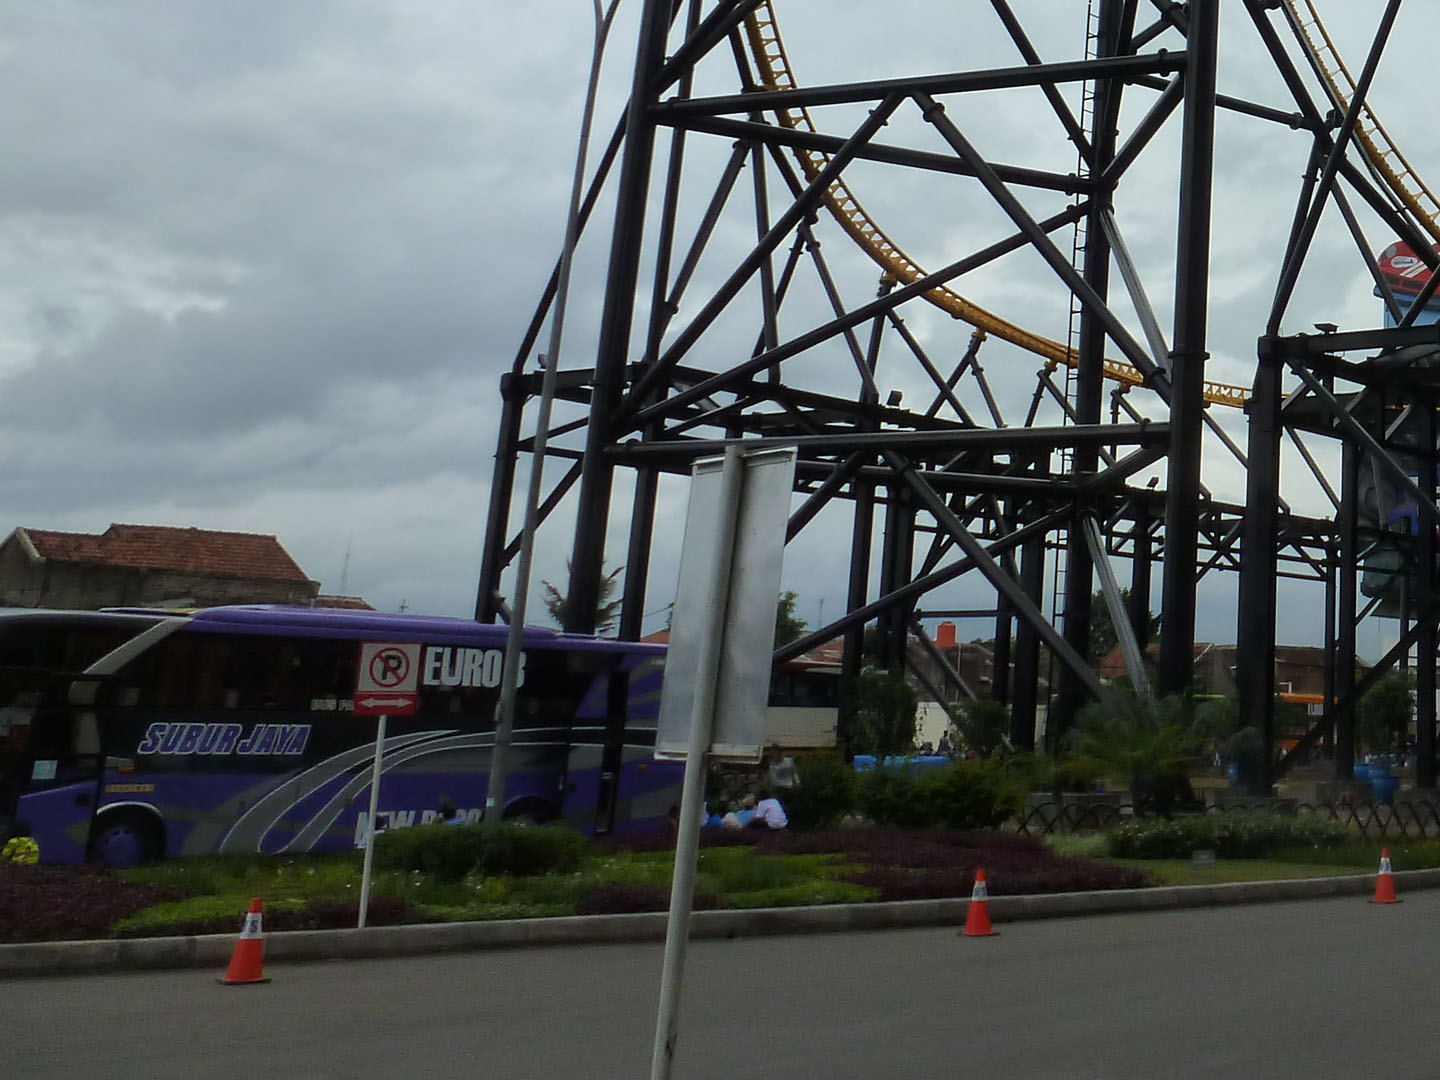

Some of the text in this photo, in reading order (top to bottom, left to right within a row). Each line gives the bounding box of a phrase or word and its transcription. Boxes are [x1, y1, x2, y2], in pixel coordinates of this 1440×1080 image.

[423, 644, 503, 689] EURO
[137, 722, 312, 755] SUBUR JAYA
